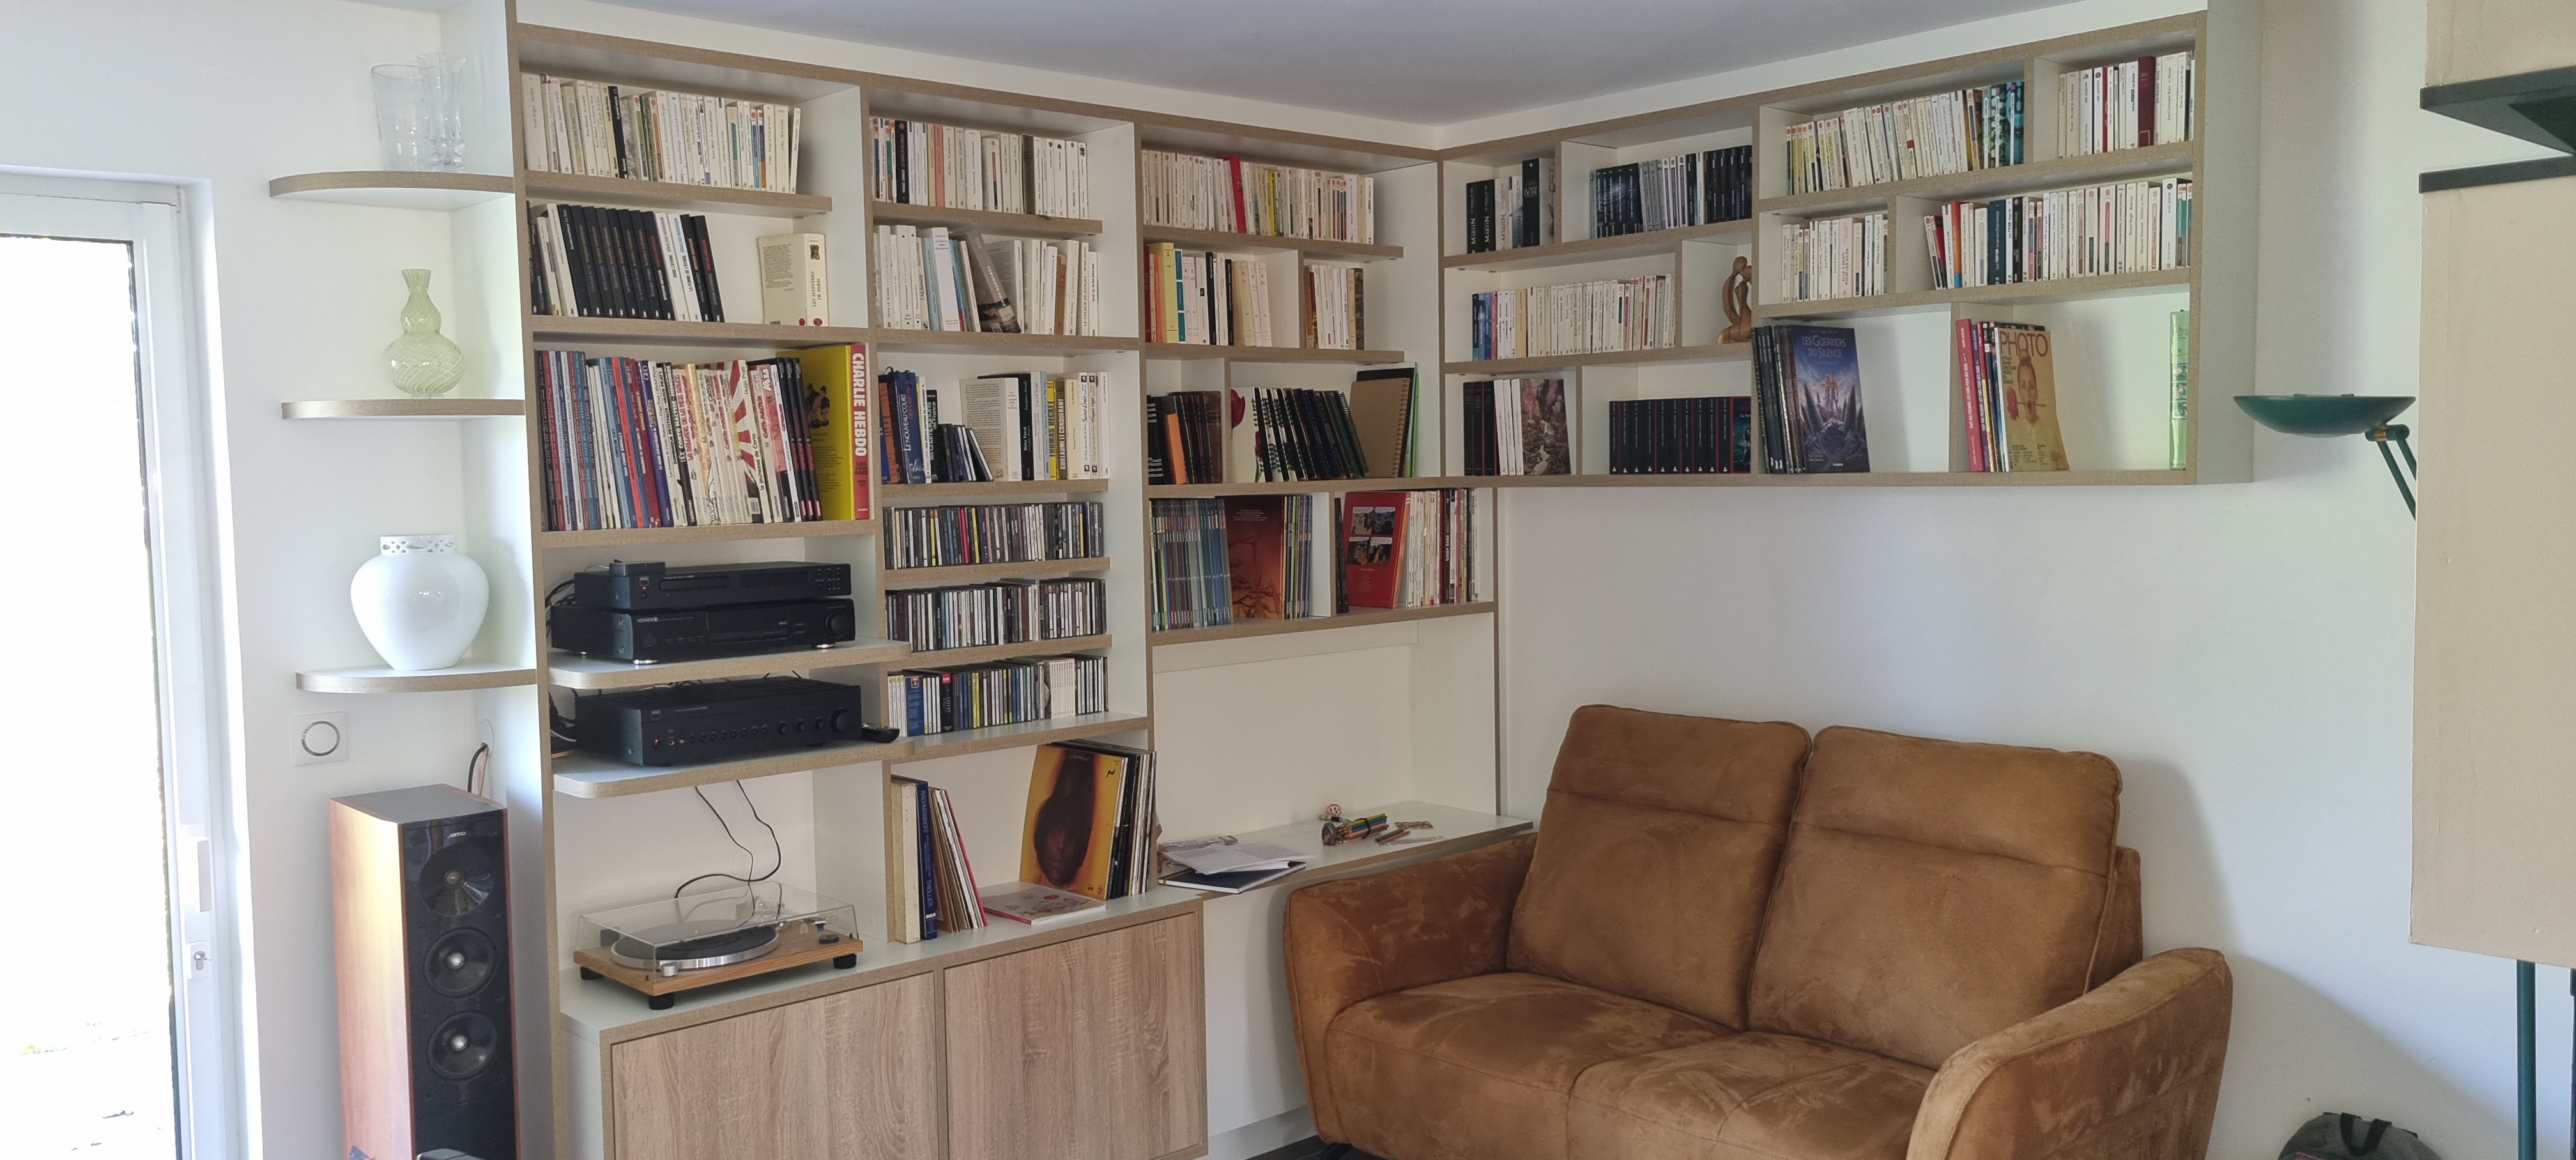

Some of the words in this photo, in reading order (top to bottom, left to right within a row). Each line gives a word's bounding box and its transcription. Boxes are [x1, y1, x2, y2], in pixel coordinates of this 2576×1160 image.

[1803, 337, 1812, 346] LES
[1813, 335, 1846, 347] GUERRIERS
[1809, 347, 1817, 356] DU
[1818, 347, 1841, 358] SILENCE
[1999, 330, 2048, 357] PHOTO
[853, 353, 866, 407] CHARLIE
[675, 429, 684, 449] CORTO
[854, 411, 867, 457] HEBDO
[756, 459, 764, 484] jeunesse
